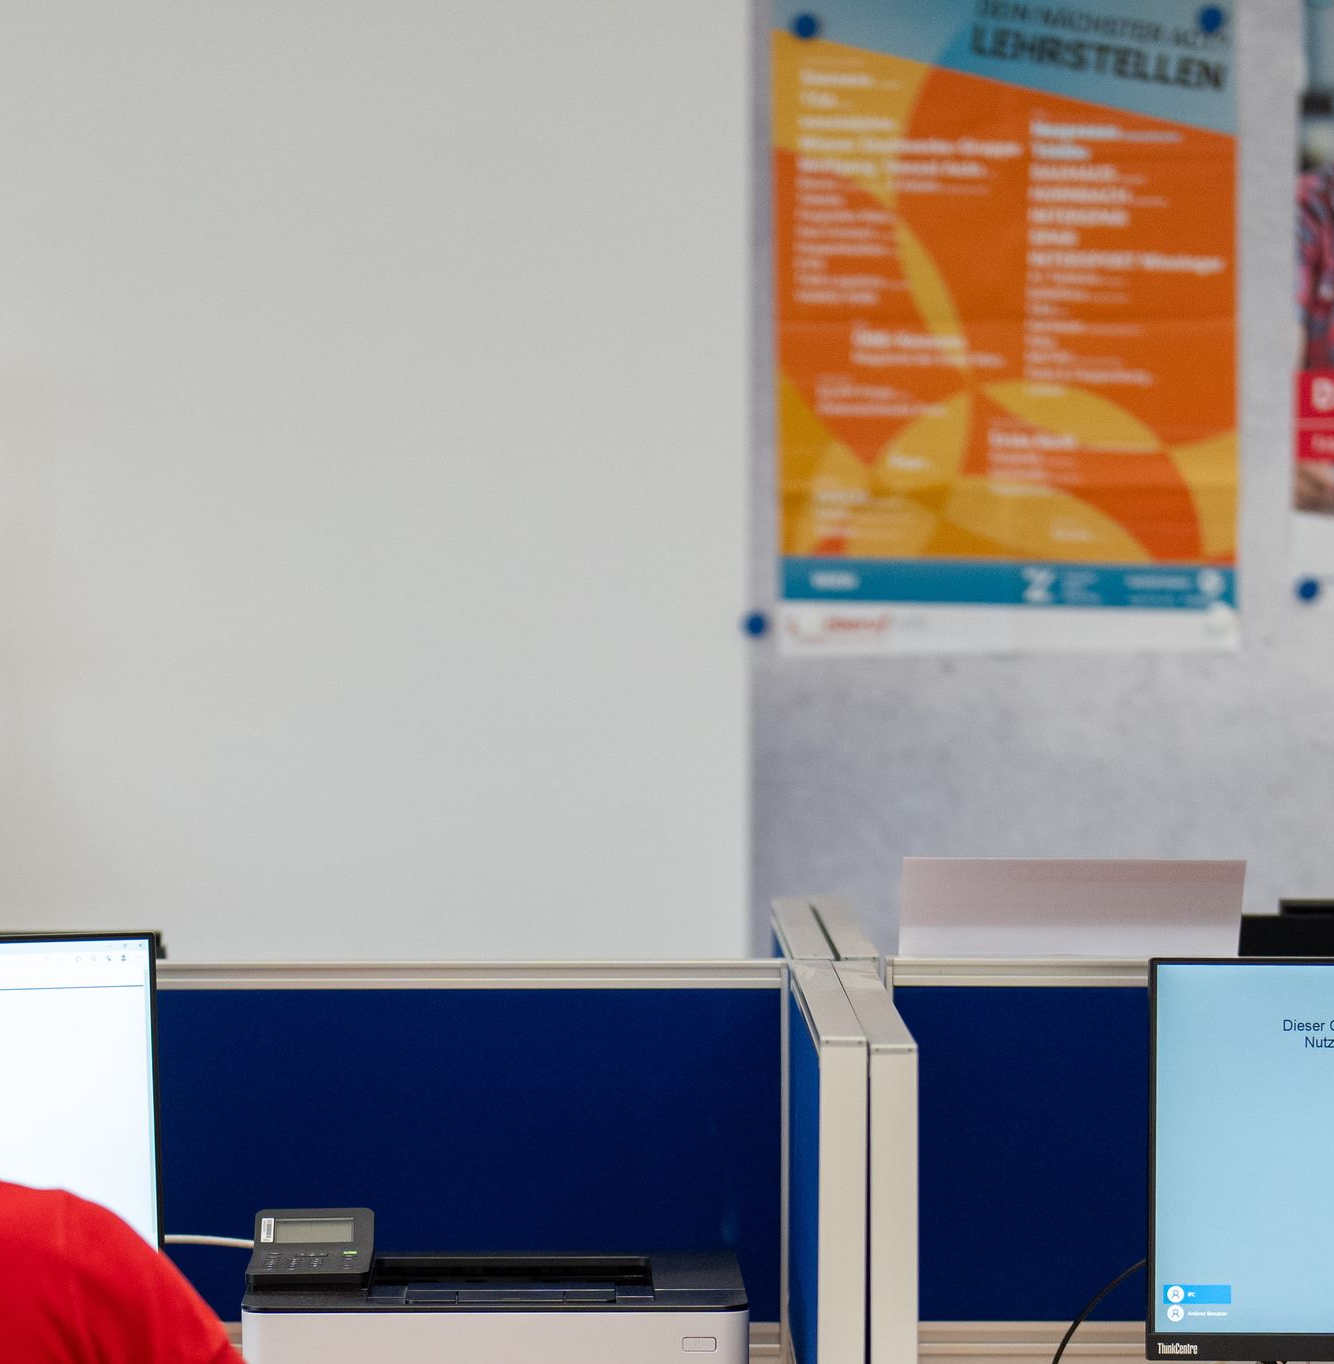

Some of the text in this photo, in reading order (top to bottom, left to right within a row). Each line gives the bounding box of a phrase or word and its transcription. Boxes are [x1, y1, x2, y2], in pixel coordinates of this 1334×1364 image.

[972, 24, 1225, 91] LEHRSTELLEN
[1282, 1019, 1325, 1032] Dieser
[1157, 1342, 1198, 1355] ThinkCentre
